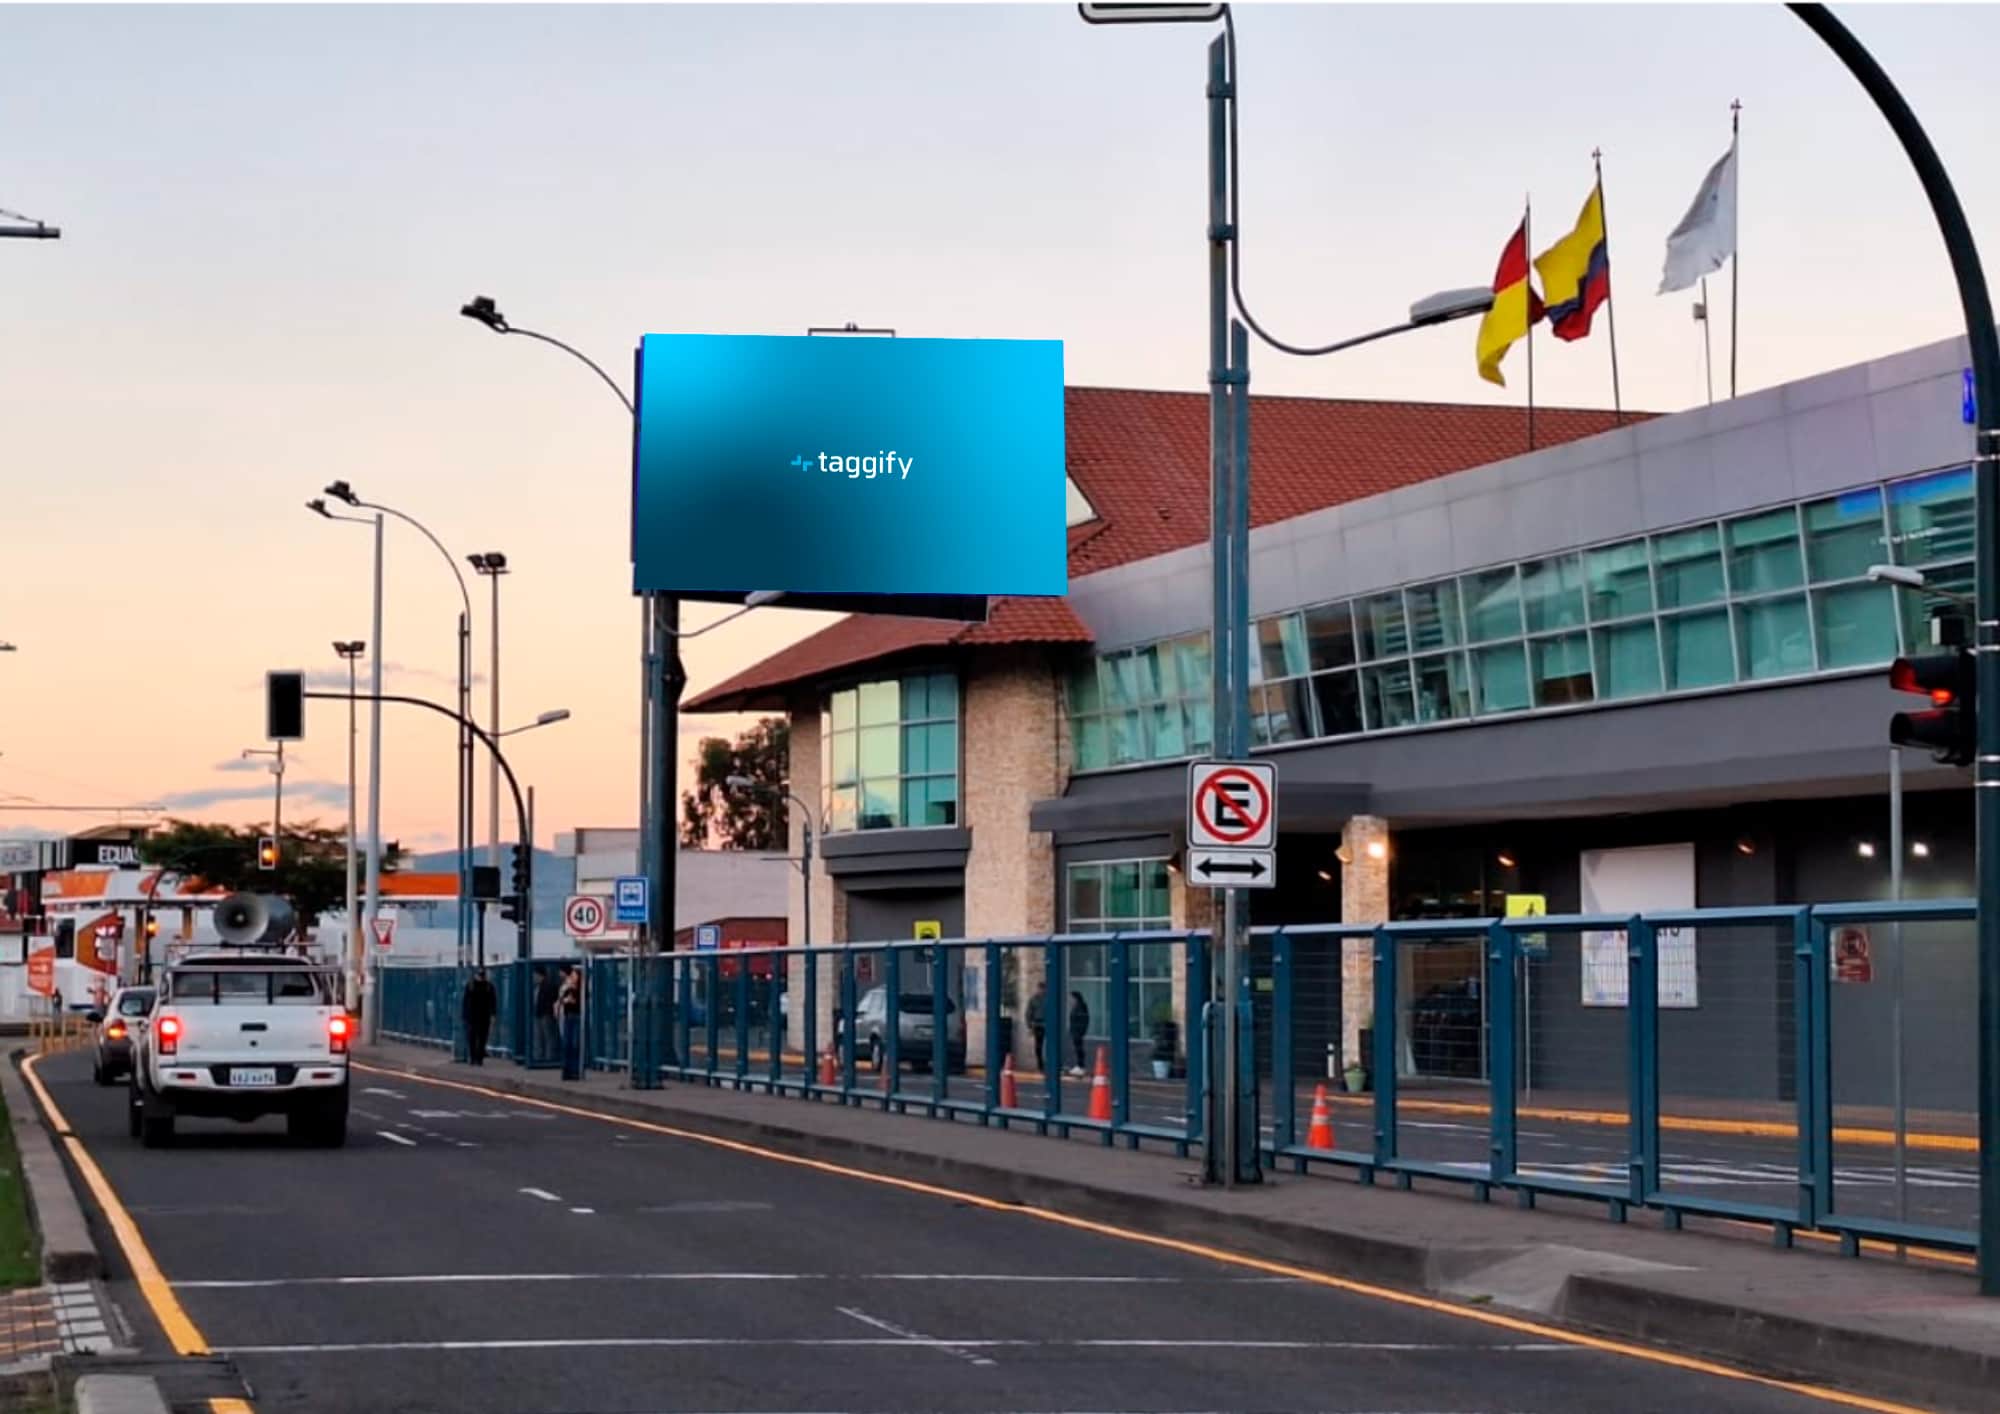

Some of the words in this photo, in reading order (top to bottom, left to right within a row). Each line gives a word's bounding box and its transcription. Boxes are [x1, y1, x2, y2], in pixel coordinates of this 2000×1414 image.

[818, 450, 913, 480] taggify
[1215, 783, 1250, 826] E
[574, 906, 596, 924] 40
